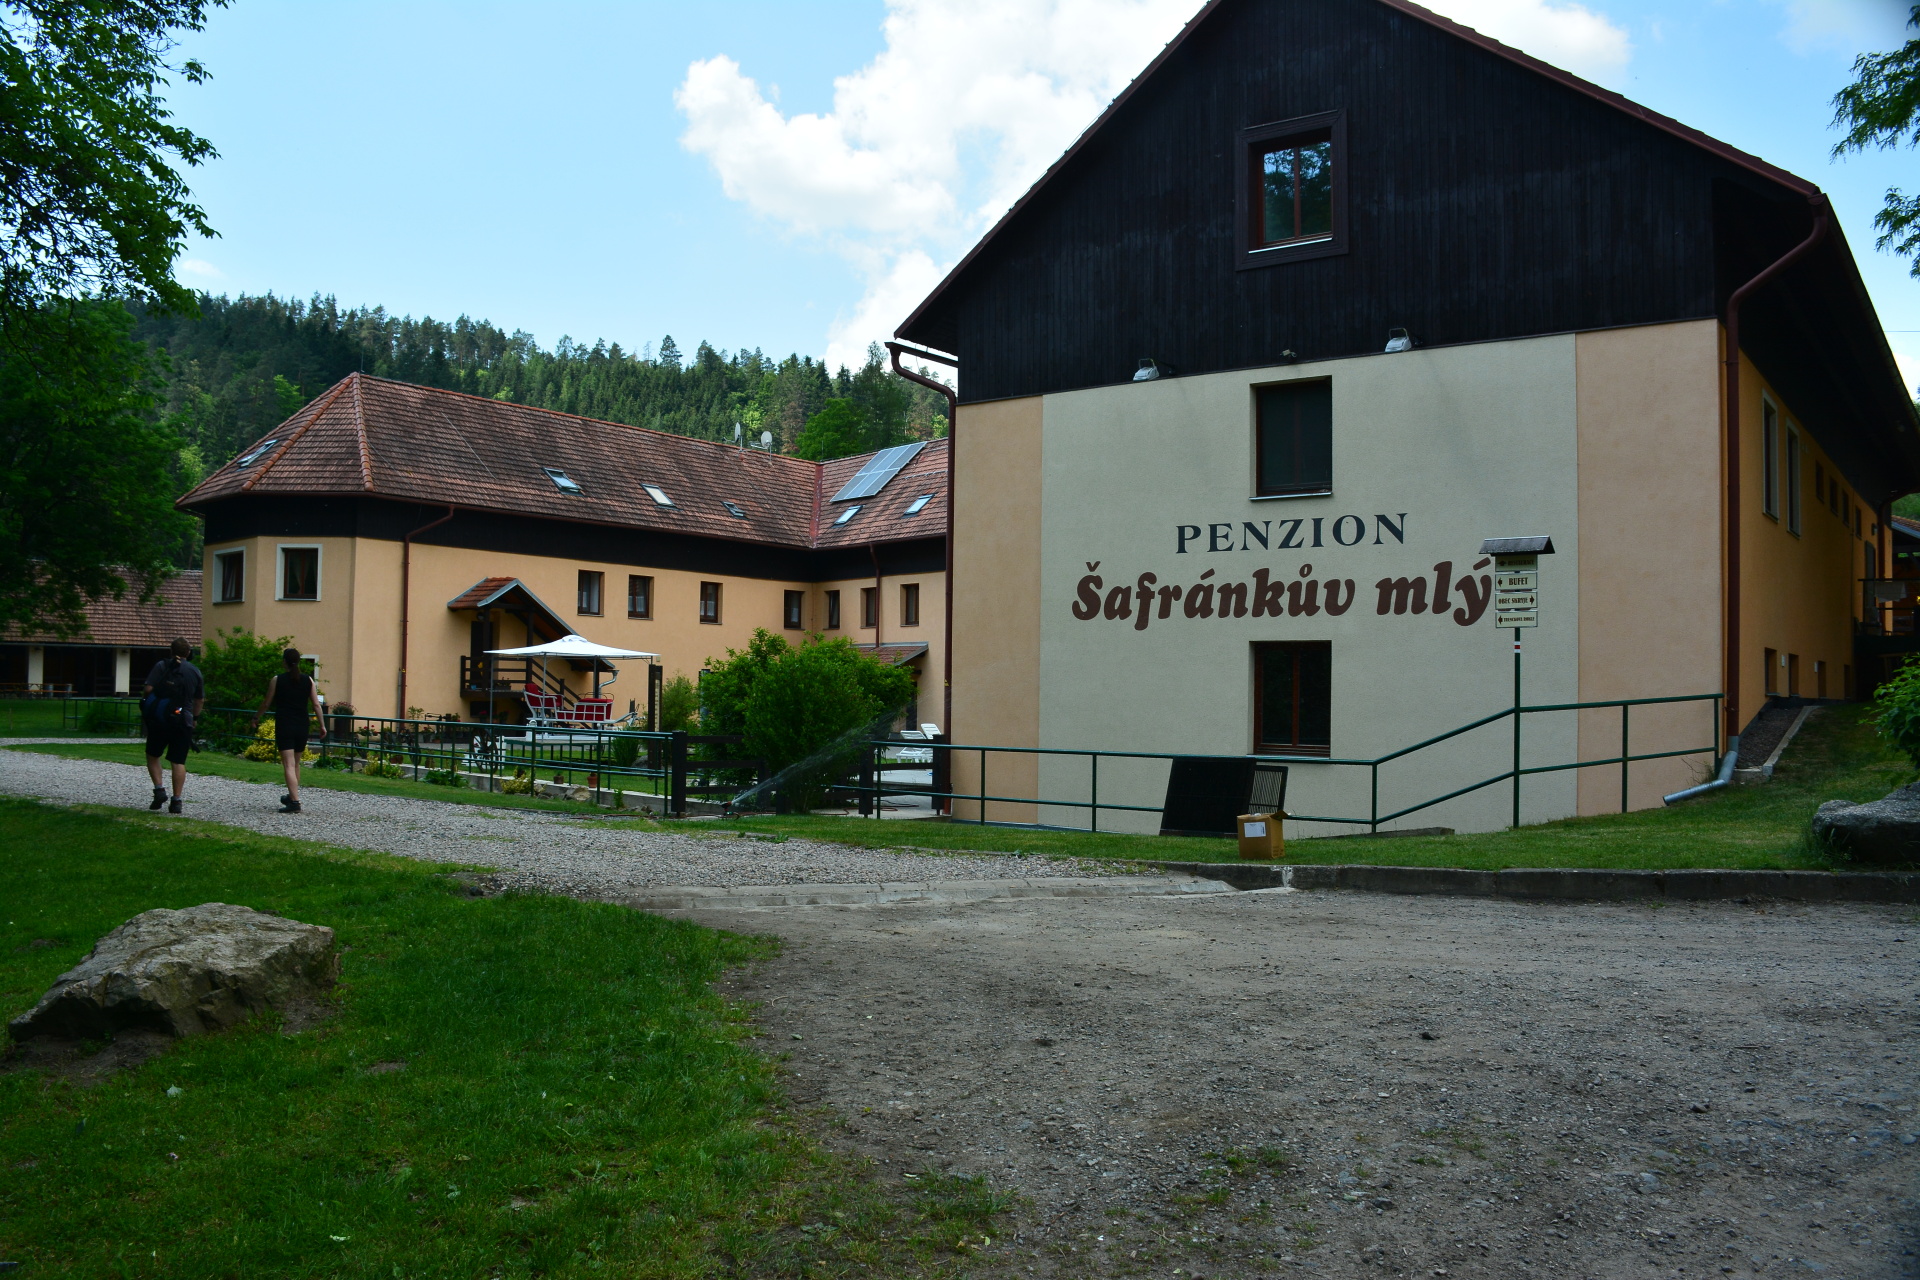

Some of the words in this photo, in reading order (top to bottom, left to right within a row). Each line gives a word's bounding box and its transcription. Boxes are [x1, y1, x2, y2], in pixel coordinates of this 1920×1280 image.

[1176, 513, 1408, 554] PENZION
[1072, 561, 1356, 631] Šafránkův
[1375, 556, 1492, 627] mlý
[1508, 577, 1528, 585] BUFET
